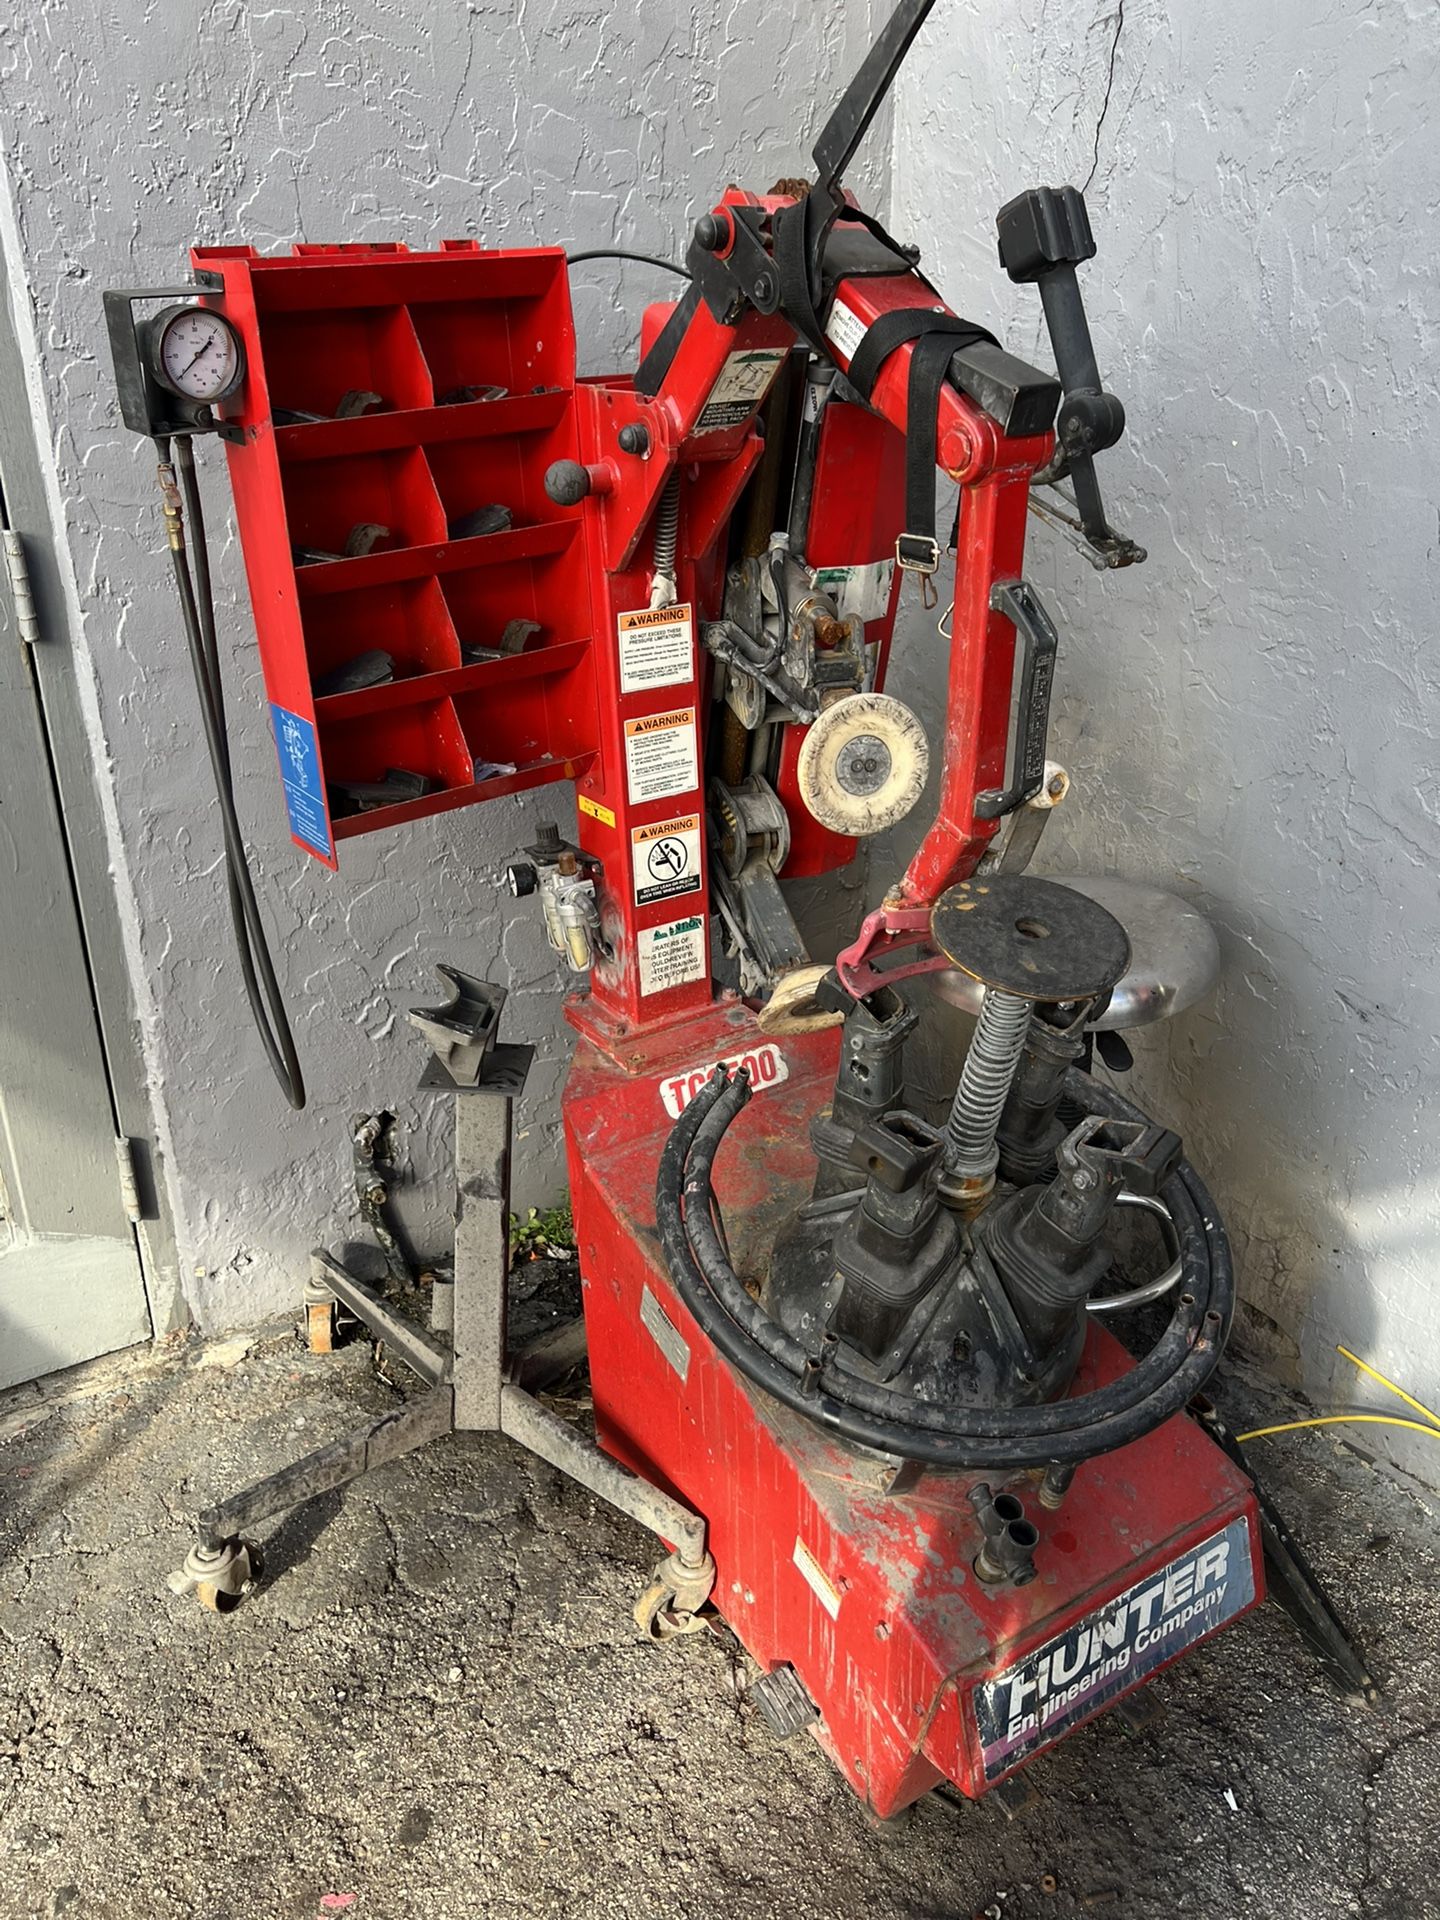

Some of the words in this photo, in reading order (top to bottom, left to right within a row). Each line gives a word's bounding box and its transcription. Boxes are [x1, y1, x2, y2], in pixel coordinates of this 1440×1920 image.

[636, 610, 684, 625] WARNING
[629, 637, 653, 645] PRESSURE
[643, 712, 689, 730] WARNING
[649, 819, 693, 836] WARNING
[1008, 1540, 1230, 1720] HUNTER
[1006, 1644, 1131, 1744] Engineering
[1134, 1582, 1228, 1654] Company
